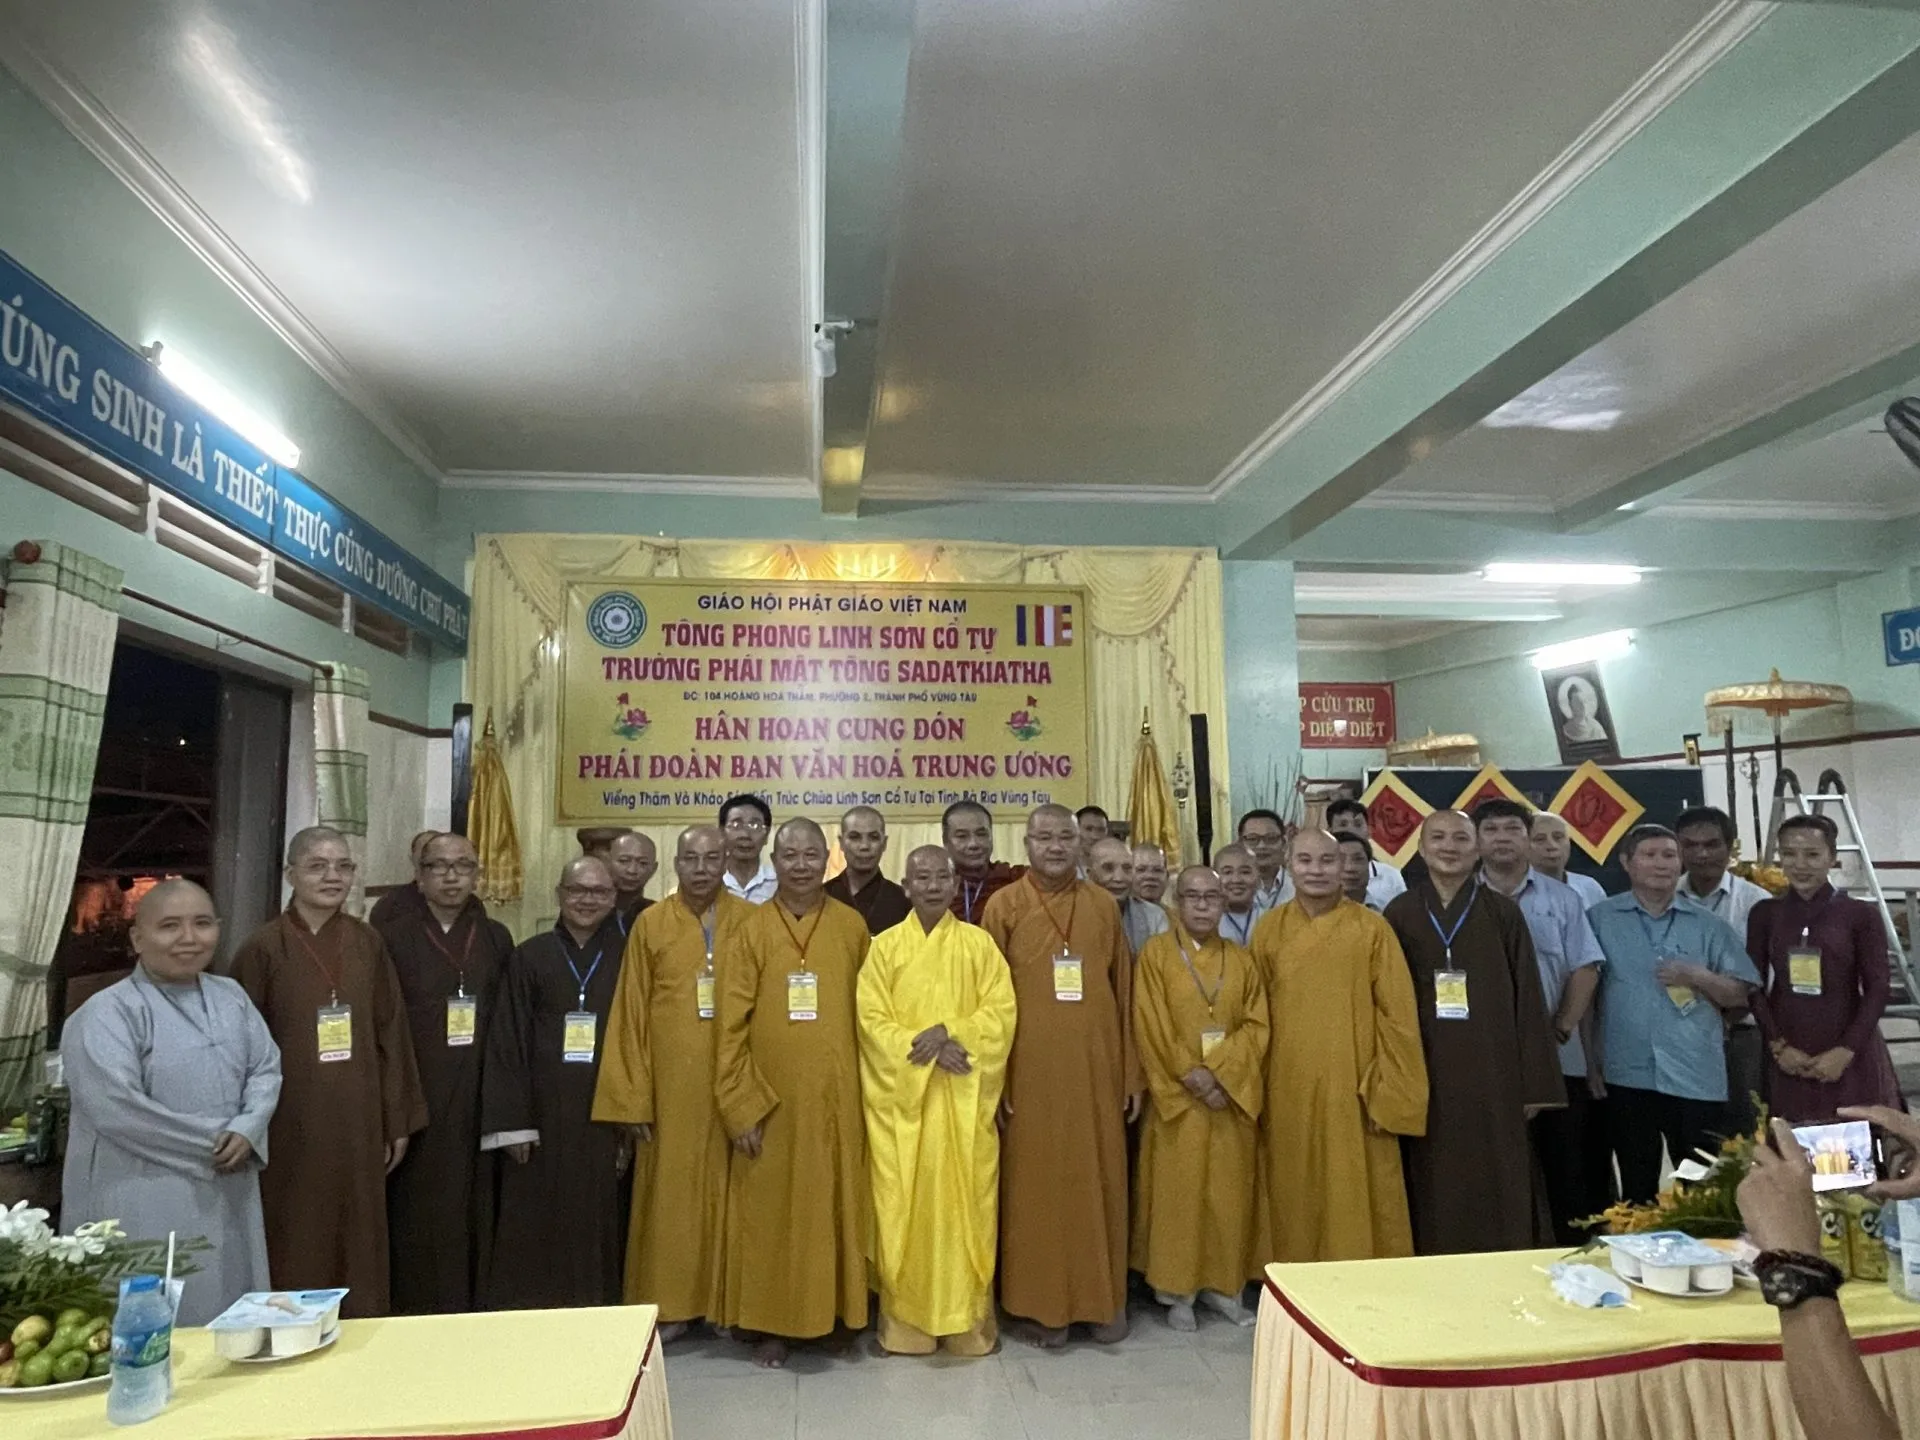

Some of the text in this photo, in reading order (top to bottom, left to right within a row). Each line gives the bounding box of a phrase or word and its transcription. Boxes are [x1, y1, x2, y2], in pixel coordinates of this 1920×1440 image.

[91, 368, 166, 457] SINH
[171, 421, 205, 483] LÀ
[213, 462, 279, 525] THIẾT
[283, 496, 331, 559] THỰC
[334, 528, 374, 584] CÚNG
[697, 592, 967, 616] GIÁO HỘI PHẬT GIÁO VIỆT NAM
[661, 618, 725, 647] TÔNG
[733, 623, 811, 648] PHONG
[818, 625, 872, 649] LINH
[879, 626, 926, 650] SƠN
[932, 617, 960, 650] CỔ
[966, 627, 997, 654] TỰ
[602, 651, 1052, 688] TRƯỜNG PHÁI MẬT TÔNG SADATKIATHA
[704, 691, 721, 701] 104
[723, 689, 761, 701] HOÀNG
[908, 688, 928, 703] PHỐ
[695, 709, 966, 741] HÂN HOAN CUNG ĐÓN
[578, 747, 1072, 779] PHÁI ĐOÀN BAN VĂN HOÁ TRUNG ƯƠNG
[602, 788, 636, 810] Viếng
[639, 790, 671, 806] Thăm
[674, 790, 690, 805] Và
[694, 789, 725, 805] Khảo
[836, 790, 859, 805] Linh
